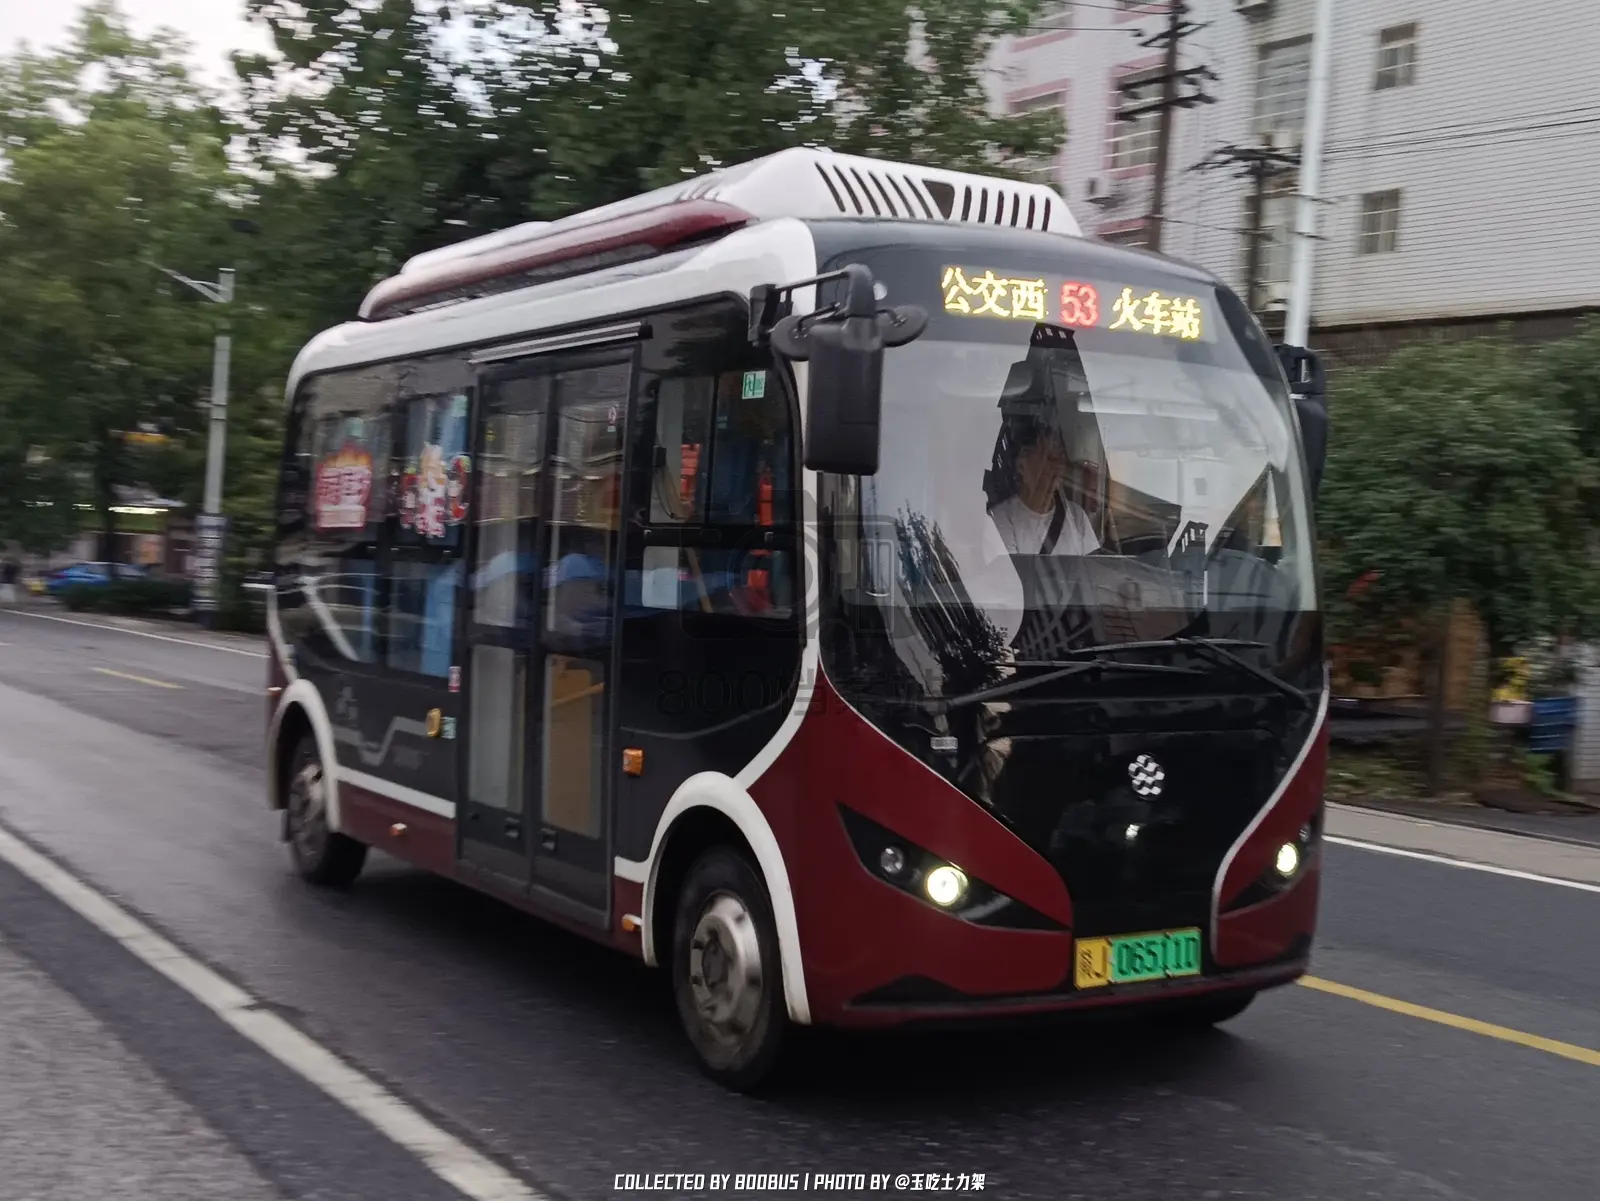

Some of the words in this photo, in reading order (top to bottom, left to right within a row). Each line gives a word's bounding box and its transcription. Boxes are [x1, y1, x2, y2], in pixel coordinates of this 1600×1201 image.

[941, 266, 1047, 320] 公交西
[1060, 281, 1099, 326] 53
[1109, 286, 1200, 339] 火车站
